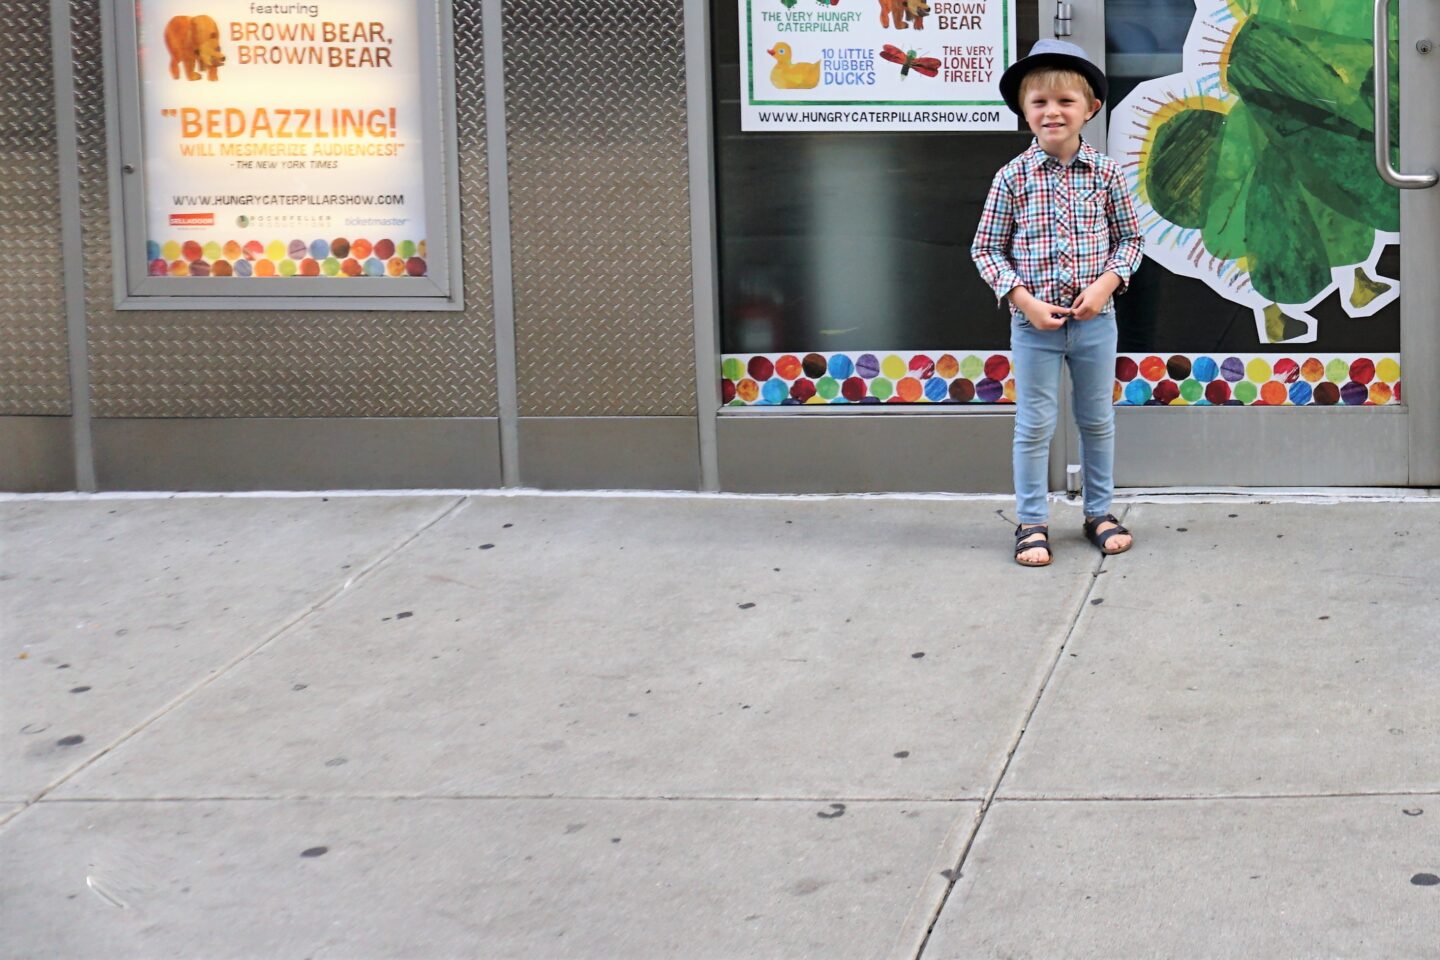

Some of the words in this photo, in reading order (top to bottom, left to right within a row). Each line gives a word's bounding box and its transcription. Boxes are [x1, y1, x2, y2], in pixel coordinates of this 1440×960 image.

[249, 2, 318, 17] featuring
[934, 3, 986, 15] BROWN
[761, 11, 781, 22] THE
[785, 11, 813, 22] VERY
[817, 11, 862, 22] HUNGRY
[777, 22, 849, 32] CATERPILLAR
[938, 16, 982, 30] BEAR
[229, 22, 315, 42] BROWN
[322, 22, 393, 44] BEAR,
[237, 45, 323, 65] BROWN
[328, 46, 392, 68] BEAR
[822, 49, 834, 60] 10
[838, 49, 874, 60] LITTLE
[942, 46, 963, 56] THE
[967, 46, 993, 56] VERY
[823, 60, 874, 71] RUBBER
[943, 57, 994, 69] LONELY
[824, 72, 876, 85] DUCKS
[944, 71, 993, 83] FIREFLY
[758, 111, 1000, 123] WWW.HUNGRYCATERPILLARSHOW.COM
[179, 144, 215, 157] WILL
[219, 143, 307, 157] MESMERIZE
[256, 160, 278, 169] NEW
[281, 160, 305, 169] YORK
[309, 160, 338, 169] TIMES
[173, 194, 404, 207] WWW.HUNGRYCATERPILLARSHOW.COM
